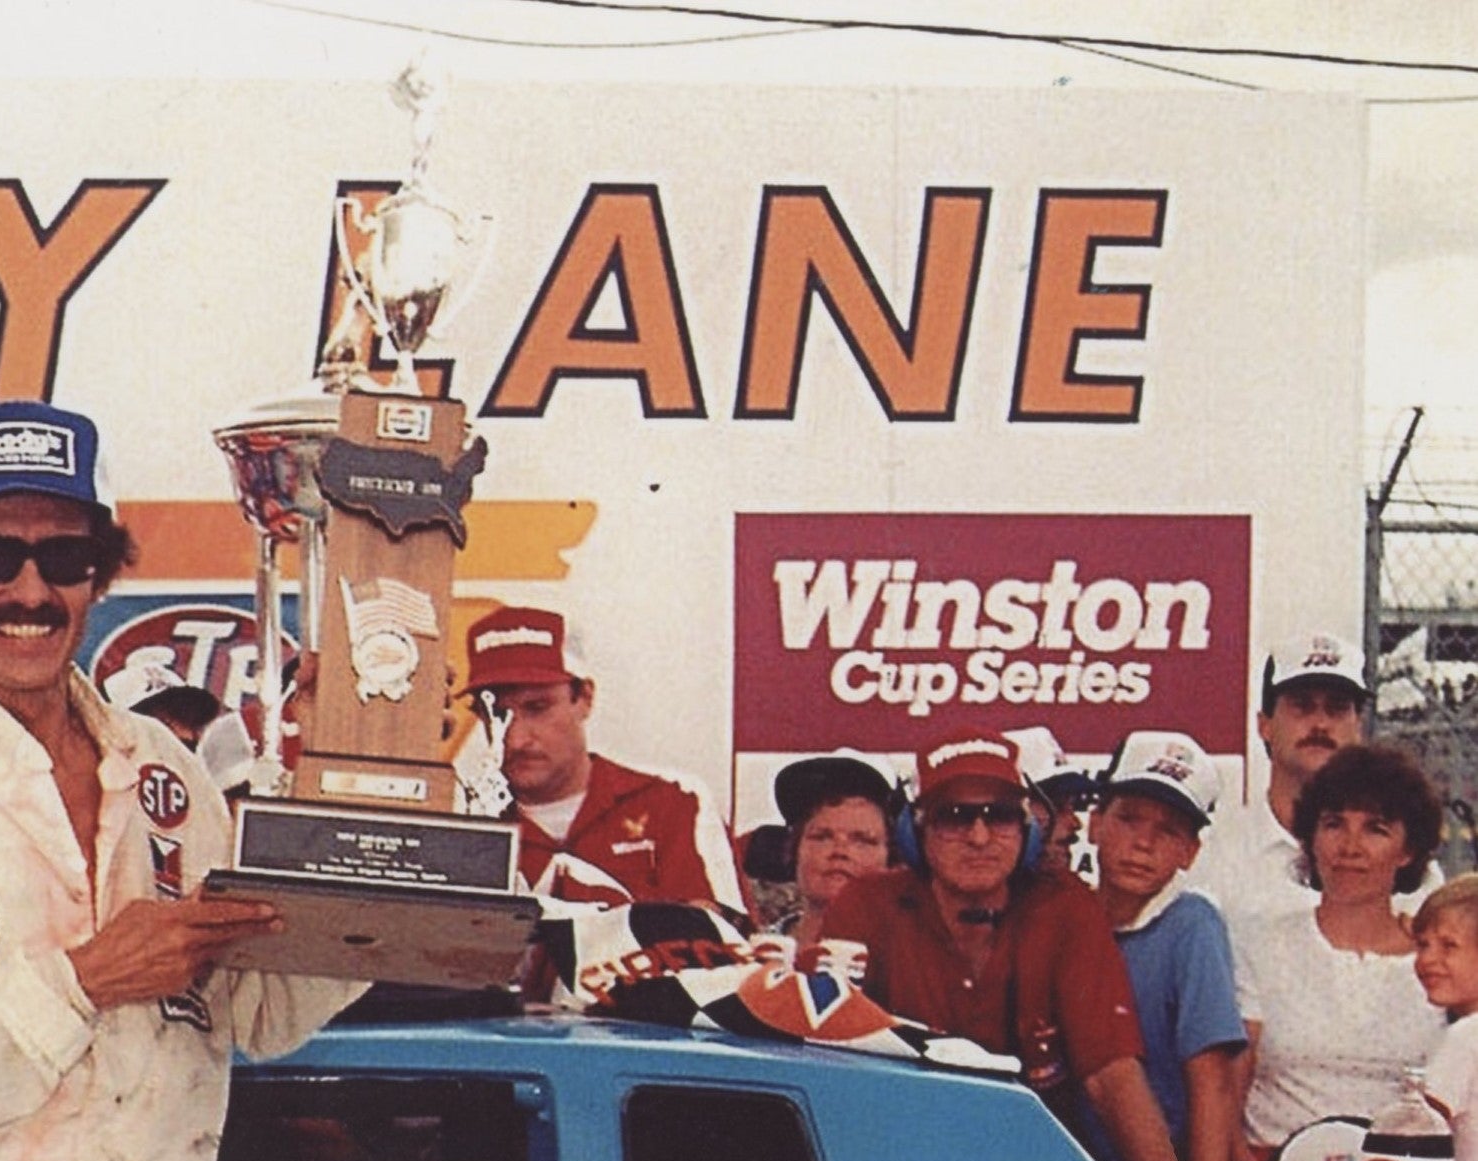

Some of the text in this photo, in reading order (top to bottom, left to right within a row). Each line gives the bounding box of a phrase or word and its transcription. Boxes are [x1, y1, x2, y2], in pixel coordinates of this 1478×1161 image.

[315, 180, 1169, 423] LANE
[774, 560, 1212, 652] Winston
[831, 651, 1152, 717] Cup Series
[143, 769, 187, 818] STP
